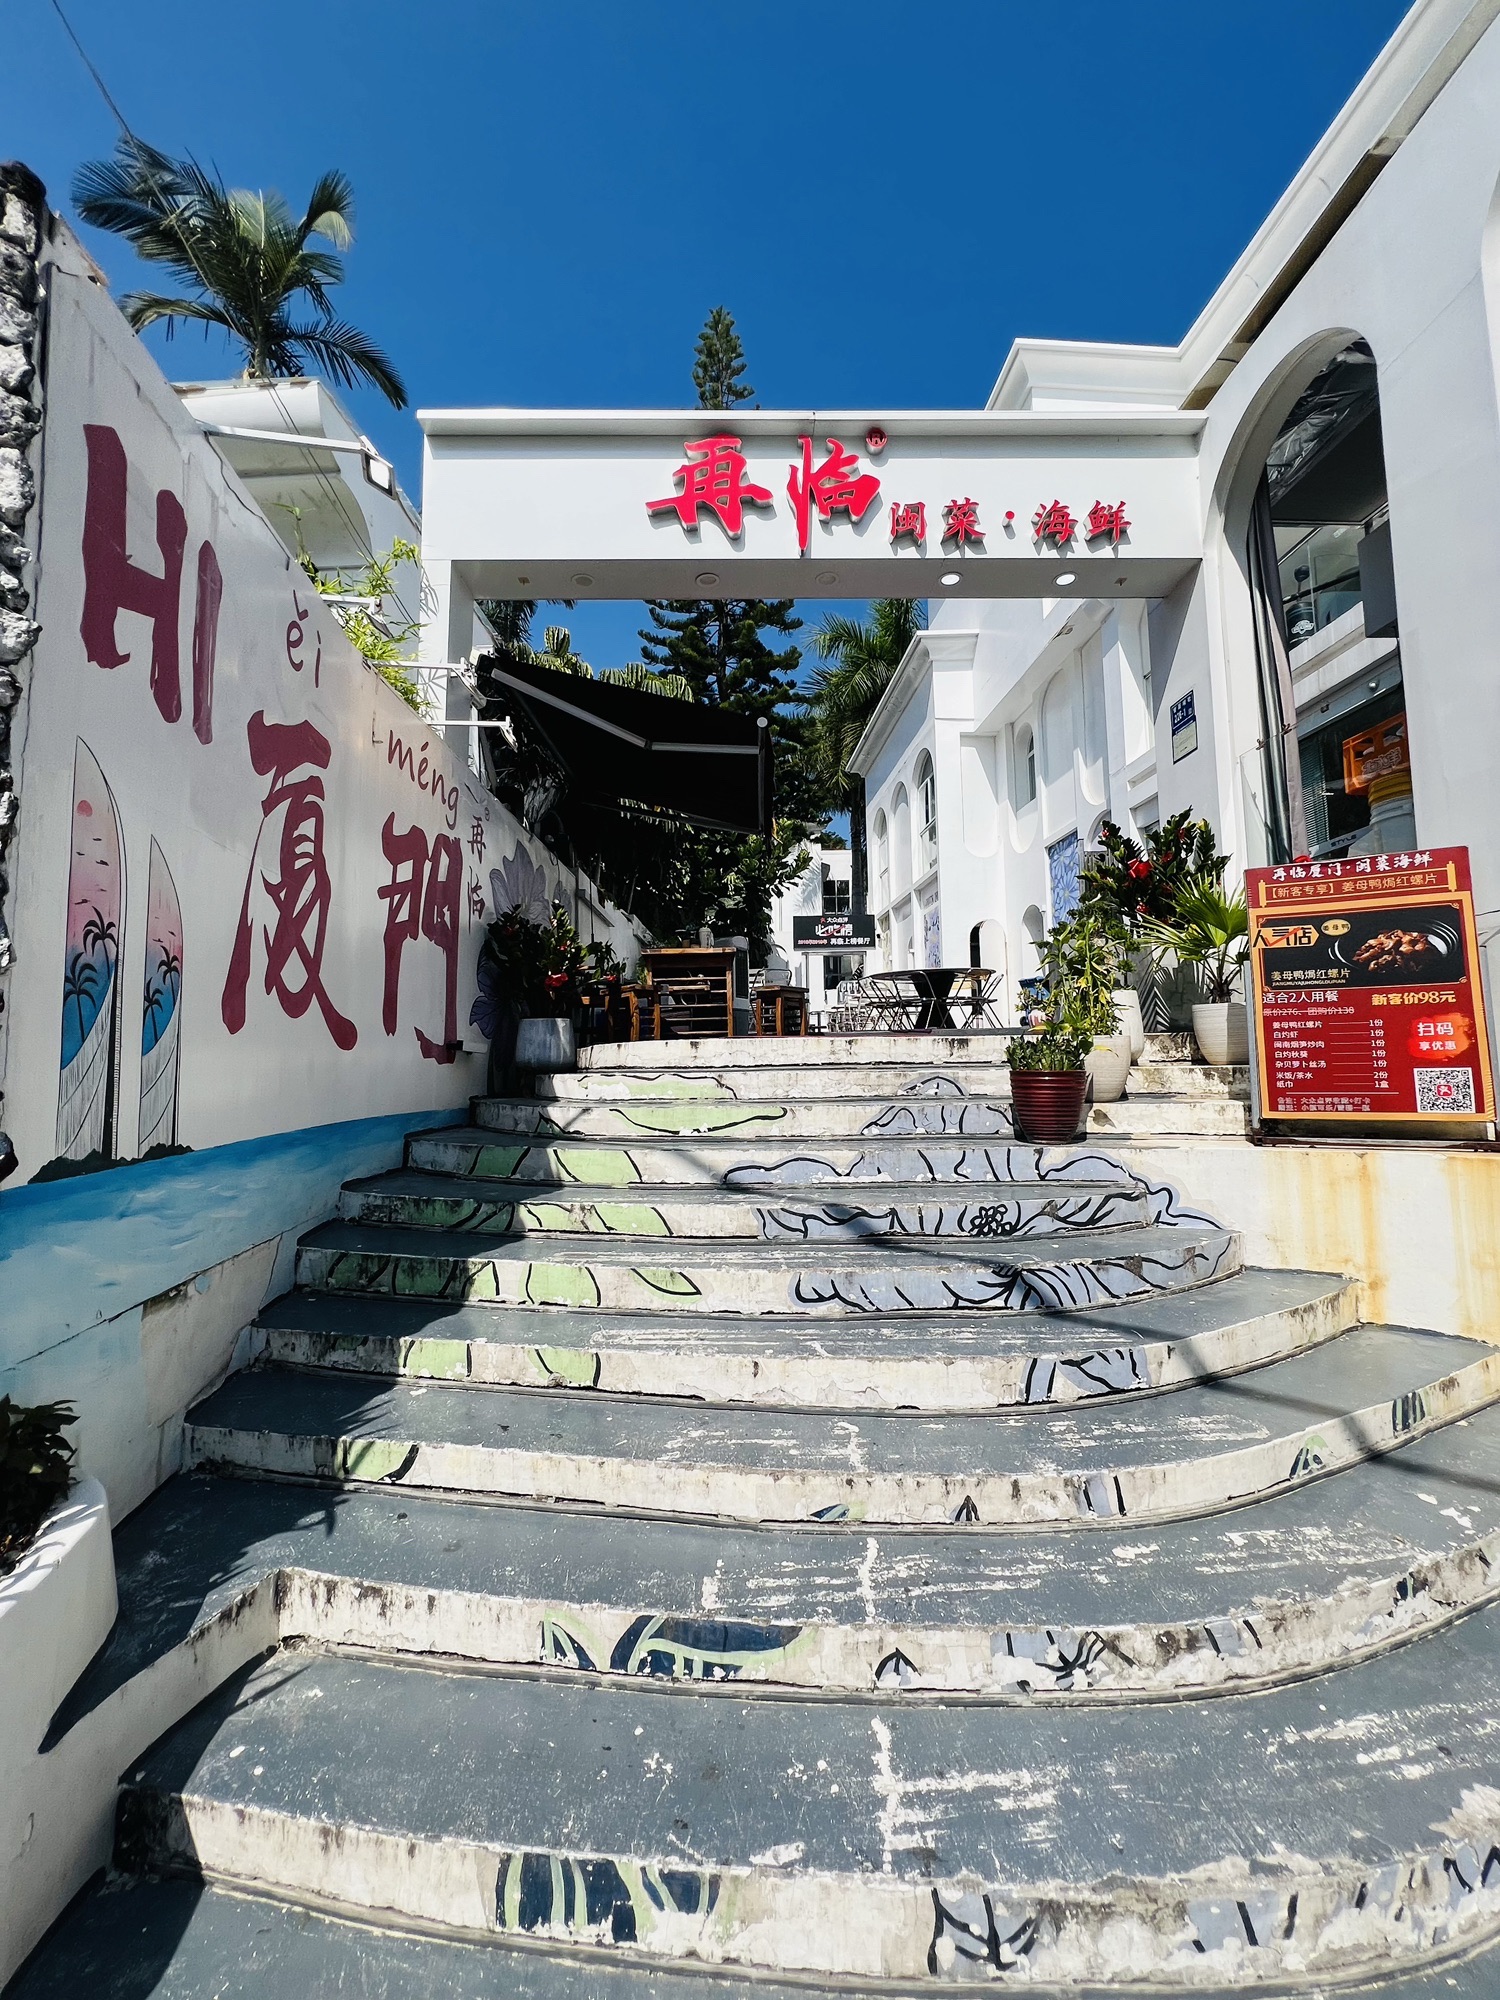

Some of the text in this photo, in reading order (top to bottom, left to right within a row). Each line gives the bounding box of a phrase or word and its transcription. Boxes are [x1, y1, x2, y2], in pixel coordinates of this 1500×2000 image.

[645, 433, 881, 558] 再临
[1330, 834, 1357, 848] STYLE
[1262, 990, 1339, 1004] 适合2人用餐
[1371, 990, 1457, 1006] 新客价98元
[1369, 1019, 1383, 1027] 1份
[1417, 1022, 1454, 1036] 扫码
[1273, 1029, 1385, 1039] 白灼虾 1份
[1371, 1039, 1385, 1047] 1份
[1419, 1041, 1457, 1050] 享优惠
[1372, 1049, 1386, 1057] 1份
[1373, 1059, 1387, 1068] 1份
[1373, 1070, 1388, 1079] 2份
[1374, 1079, 1390, 1088] 1盒
